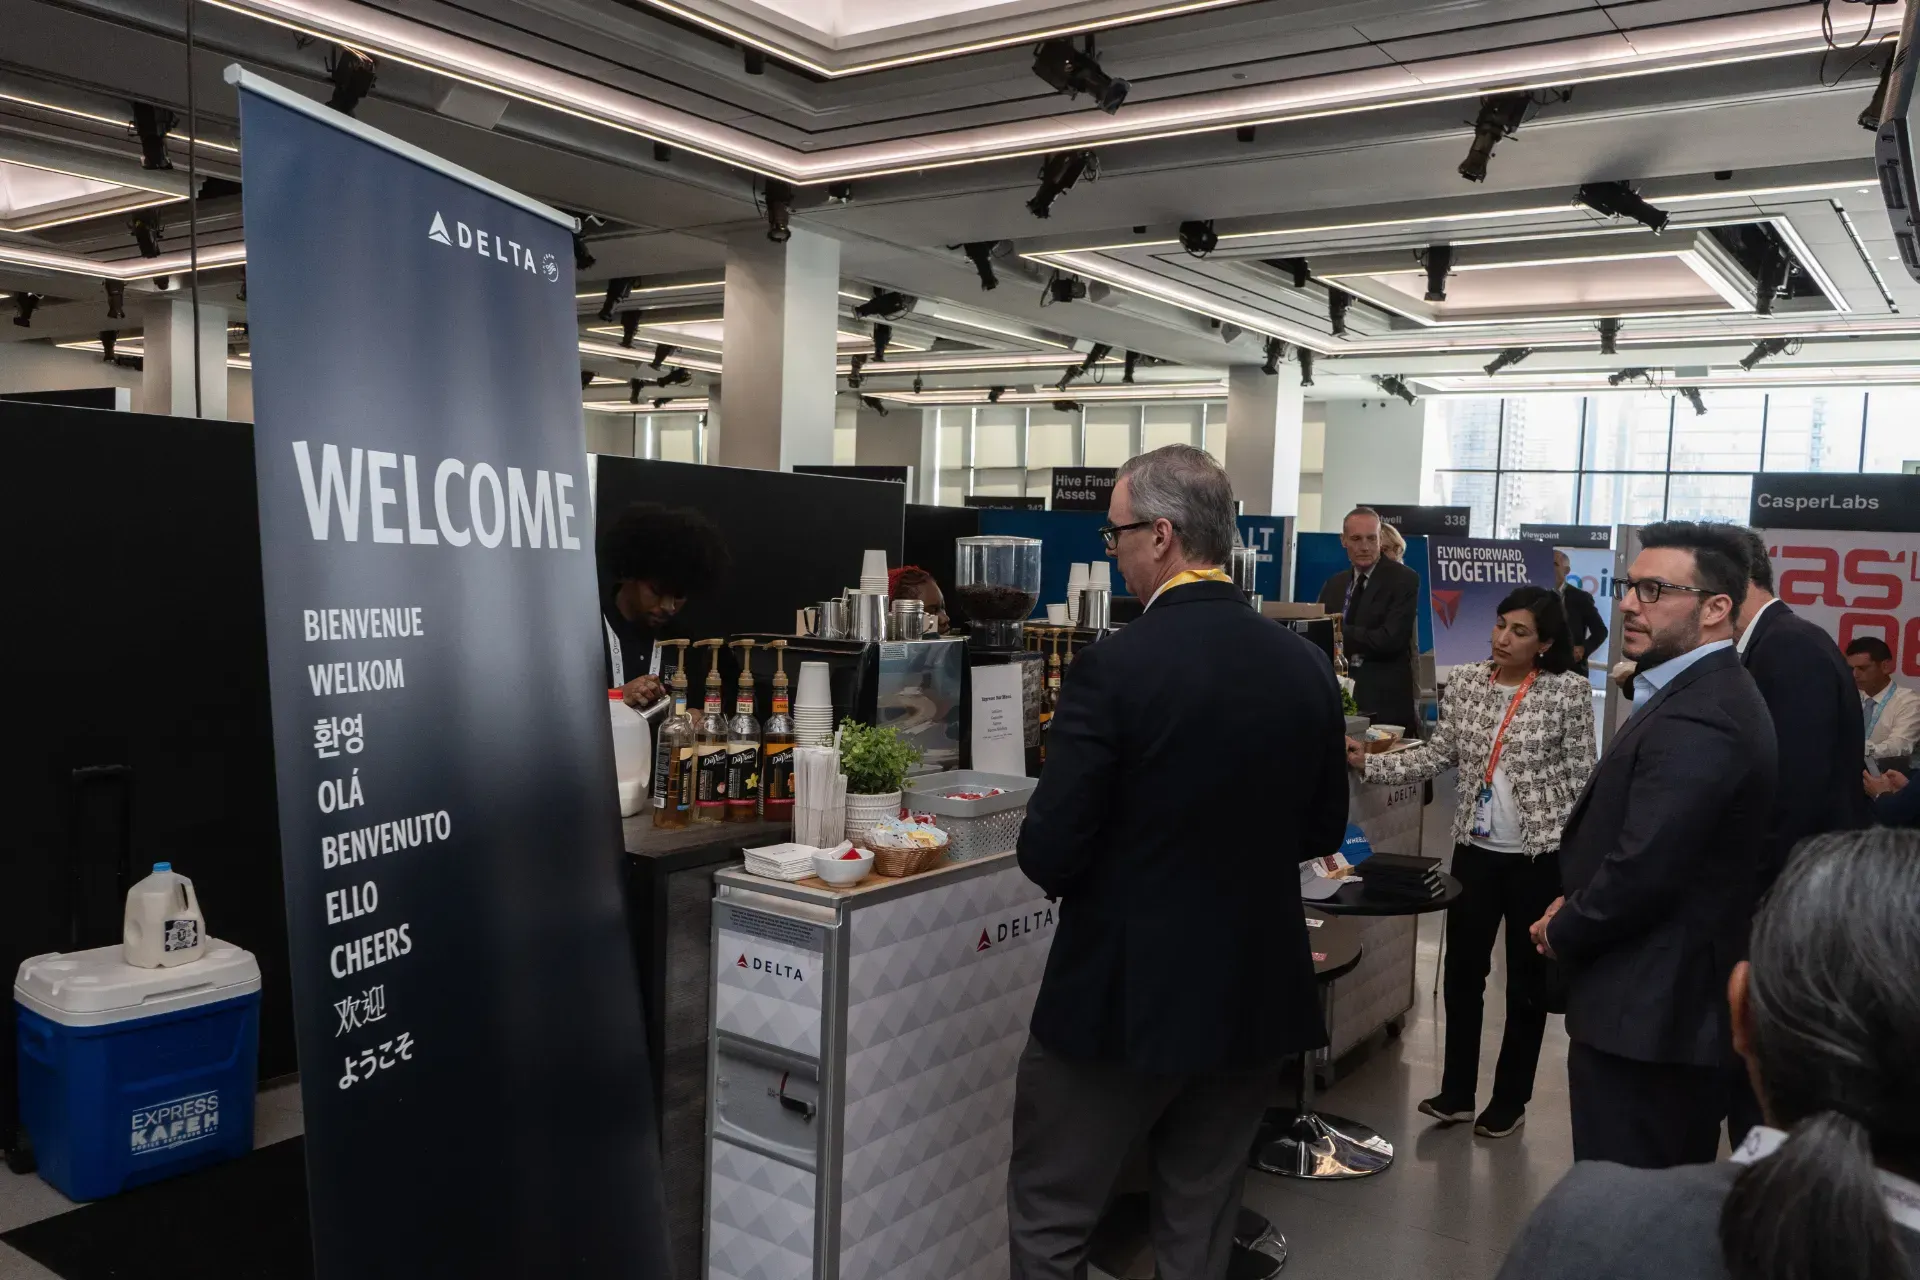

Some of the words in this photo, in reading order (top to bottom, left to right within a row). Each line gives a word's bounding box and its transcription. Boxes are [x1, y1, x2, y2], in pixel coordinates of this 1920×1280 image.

[457, 221, 537, 274] DELTA
[292, 440, 581, 550] WELCOME
[1055, 474, 1082, 486] Hive
[1055, 488, 1097, 501] Assets
[1757, 493, 1880, 511] CasperLabs
[1444, 515, 1467, 526] 338
[1522, 531, 1560, 540] Viewpoint
[1590, 532, 1609, 541] 238
[1437, 545, 1471, 560] FLYING
[1473, 547, 1525, 563] FORWARD,
[1438, 560, 1532, 584] TOGETHER.
[303, 607, 425, 642] BIENVENUE
[308, 658, 405, 697] WELKOM
[313, 713, 365, 759] 환영
[772, 751, 794, 765] DaVinc
[318, 767, 365, 814] OLÁ
[1394, 784, 1417, 803] DELTA
[321, 810, 452, 870] BENVENUTO
[325, 880, 379, 925] ELLO
[997, 908, 1054, 943] DELTA
[330, 923, 413, 979] CHEERS
[753, 957, 804, 982] DELTA
[333, 984, 388, 1038] 欢迎
[338, 1031, 415, 1090] ようこそ
[131, 1095, 219, 1131] EXPRESS
[131, 1110, 219, 1147] KAFEH
